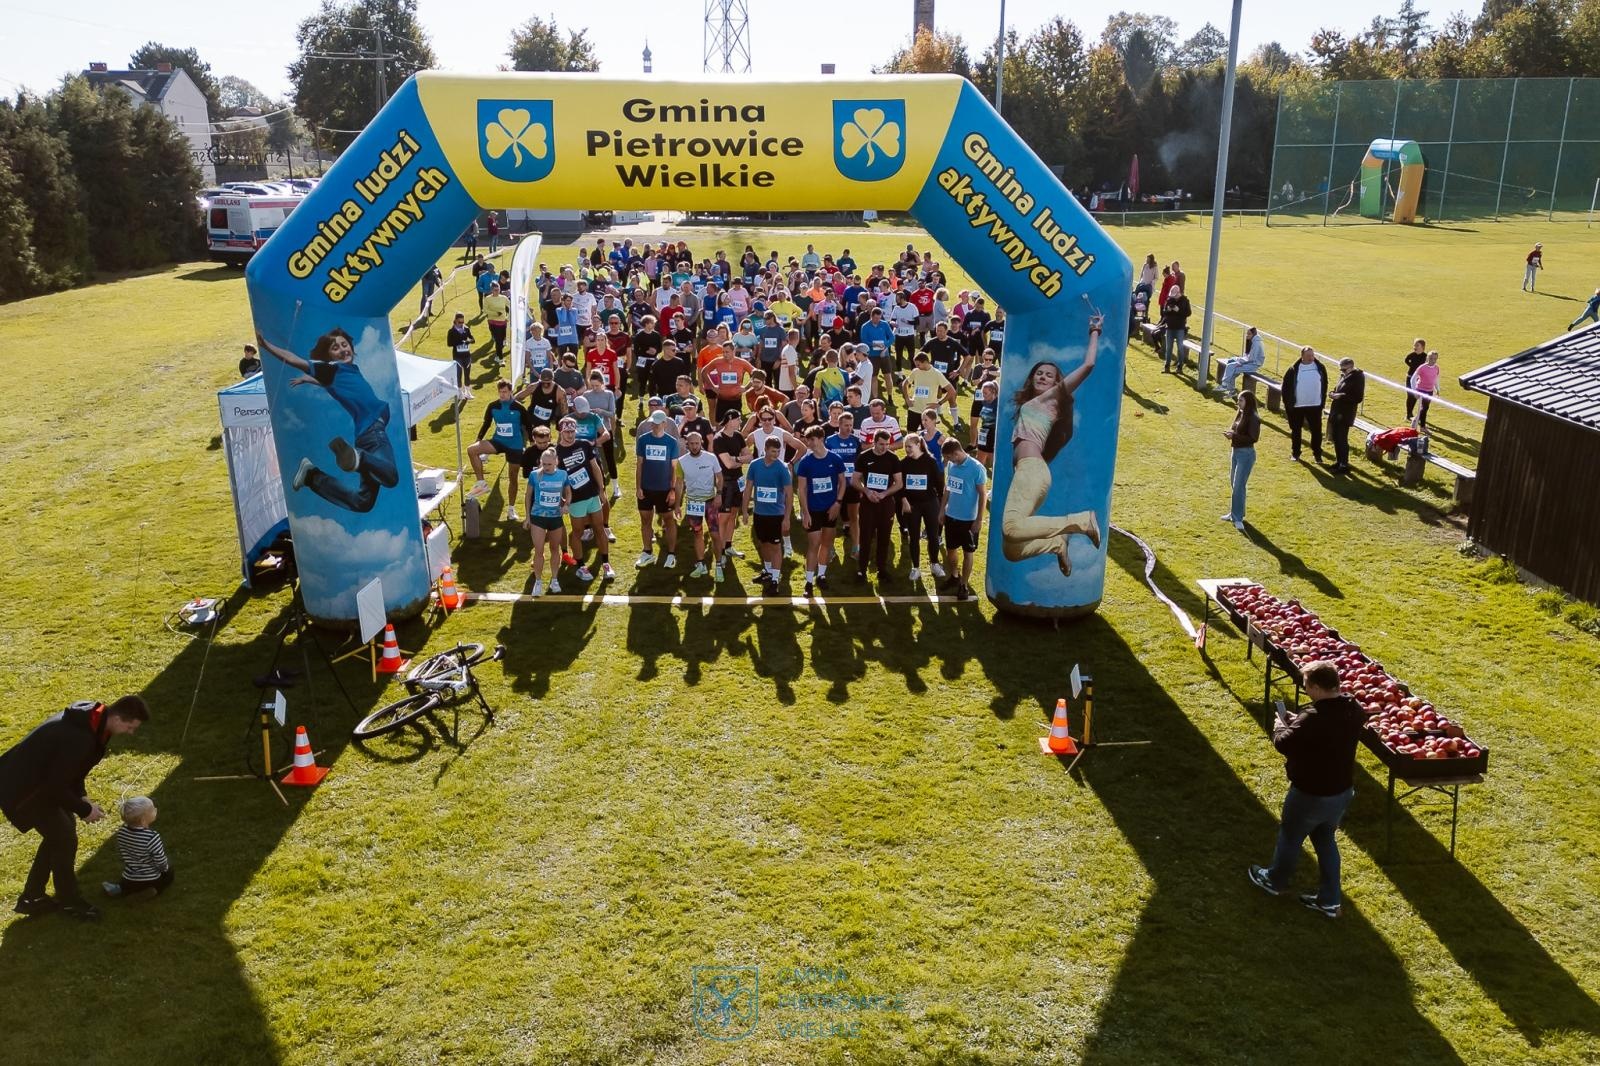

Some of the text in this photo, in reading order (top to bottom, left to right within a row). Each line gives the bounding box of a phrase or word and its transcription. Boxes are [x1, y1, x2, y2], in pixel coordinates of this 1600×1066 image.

[623, 98, 765, 123] Gmina
[586, 129, 804, 158] Pietrowice
[616, 163, 775, 188] Wielkie
[288, 130, 421, 279] Gmina ludzi
[963, 133, 1095, 276] Gmina ludzi
[323, 167, 449, 302] aktywnych
[938, 167, 1063, 298] aktywnych
[689, 504, 702, 512] 121
[762, 490, 772, 498] 72
